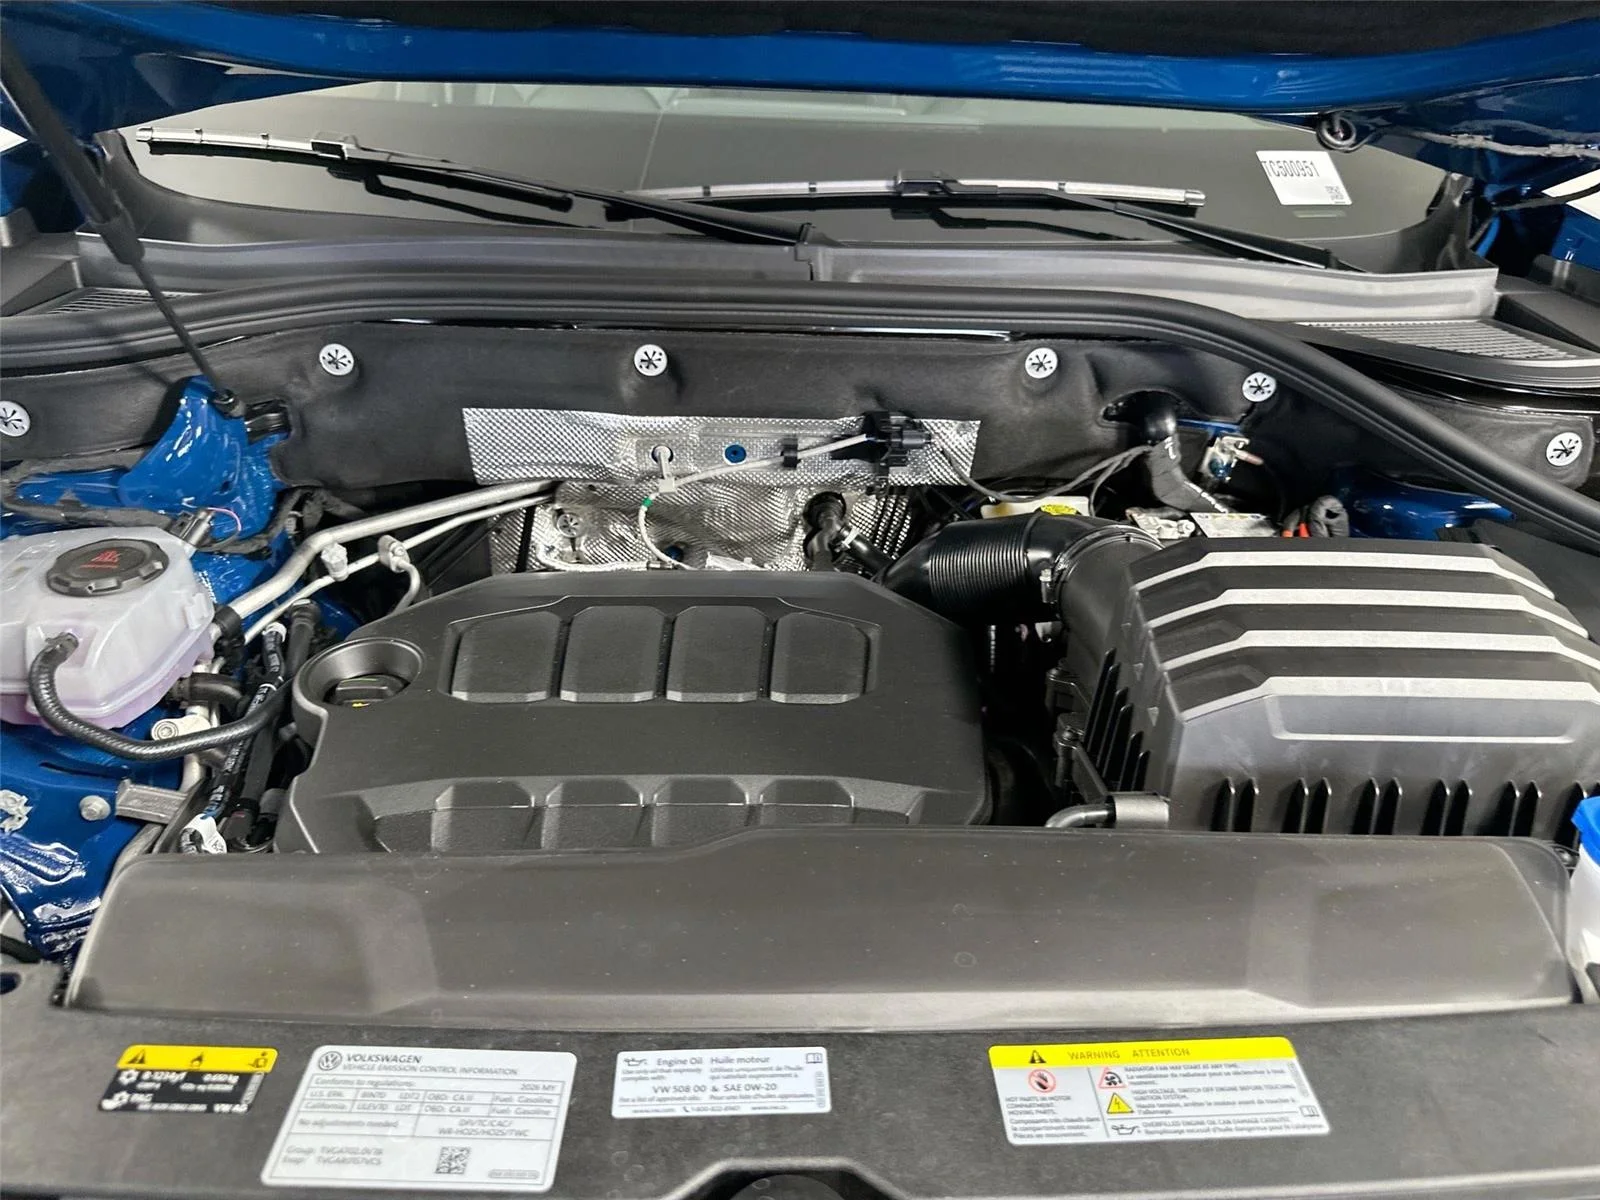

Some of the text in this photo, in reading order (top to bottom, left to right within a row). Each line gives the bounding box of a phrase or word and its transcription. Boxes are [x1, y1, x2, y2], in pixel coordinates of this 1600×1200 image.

[1261, 160, 1320, 177] TC500951
[347, 1054, 422, 1064] VOLKSWAGEN
[1067, 1048, 1191, 1060] WARNING ATTENTION
[656, 1058, 688, 1067] Engine
[377, 1064, 417, 1072] EMISSION
[420, 1065, 457, 1073] CONTROL
[459, 1067, 518, 1075] INFORMATION
[652, 1085, 671, 1093] VW
[672, 1085, 692, 1093] 508
[693, 1084, 707, 1092] 00
[723, 1083, 742, 1092] SAE
[744, 1082, 778, 1091] 0W-20
[517, 1095, 553, 1104] Gasoline
[514, 1107, 550, 1116] Gasoline
